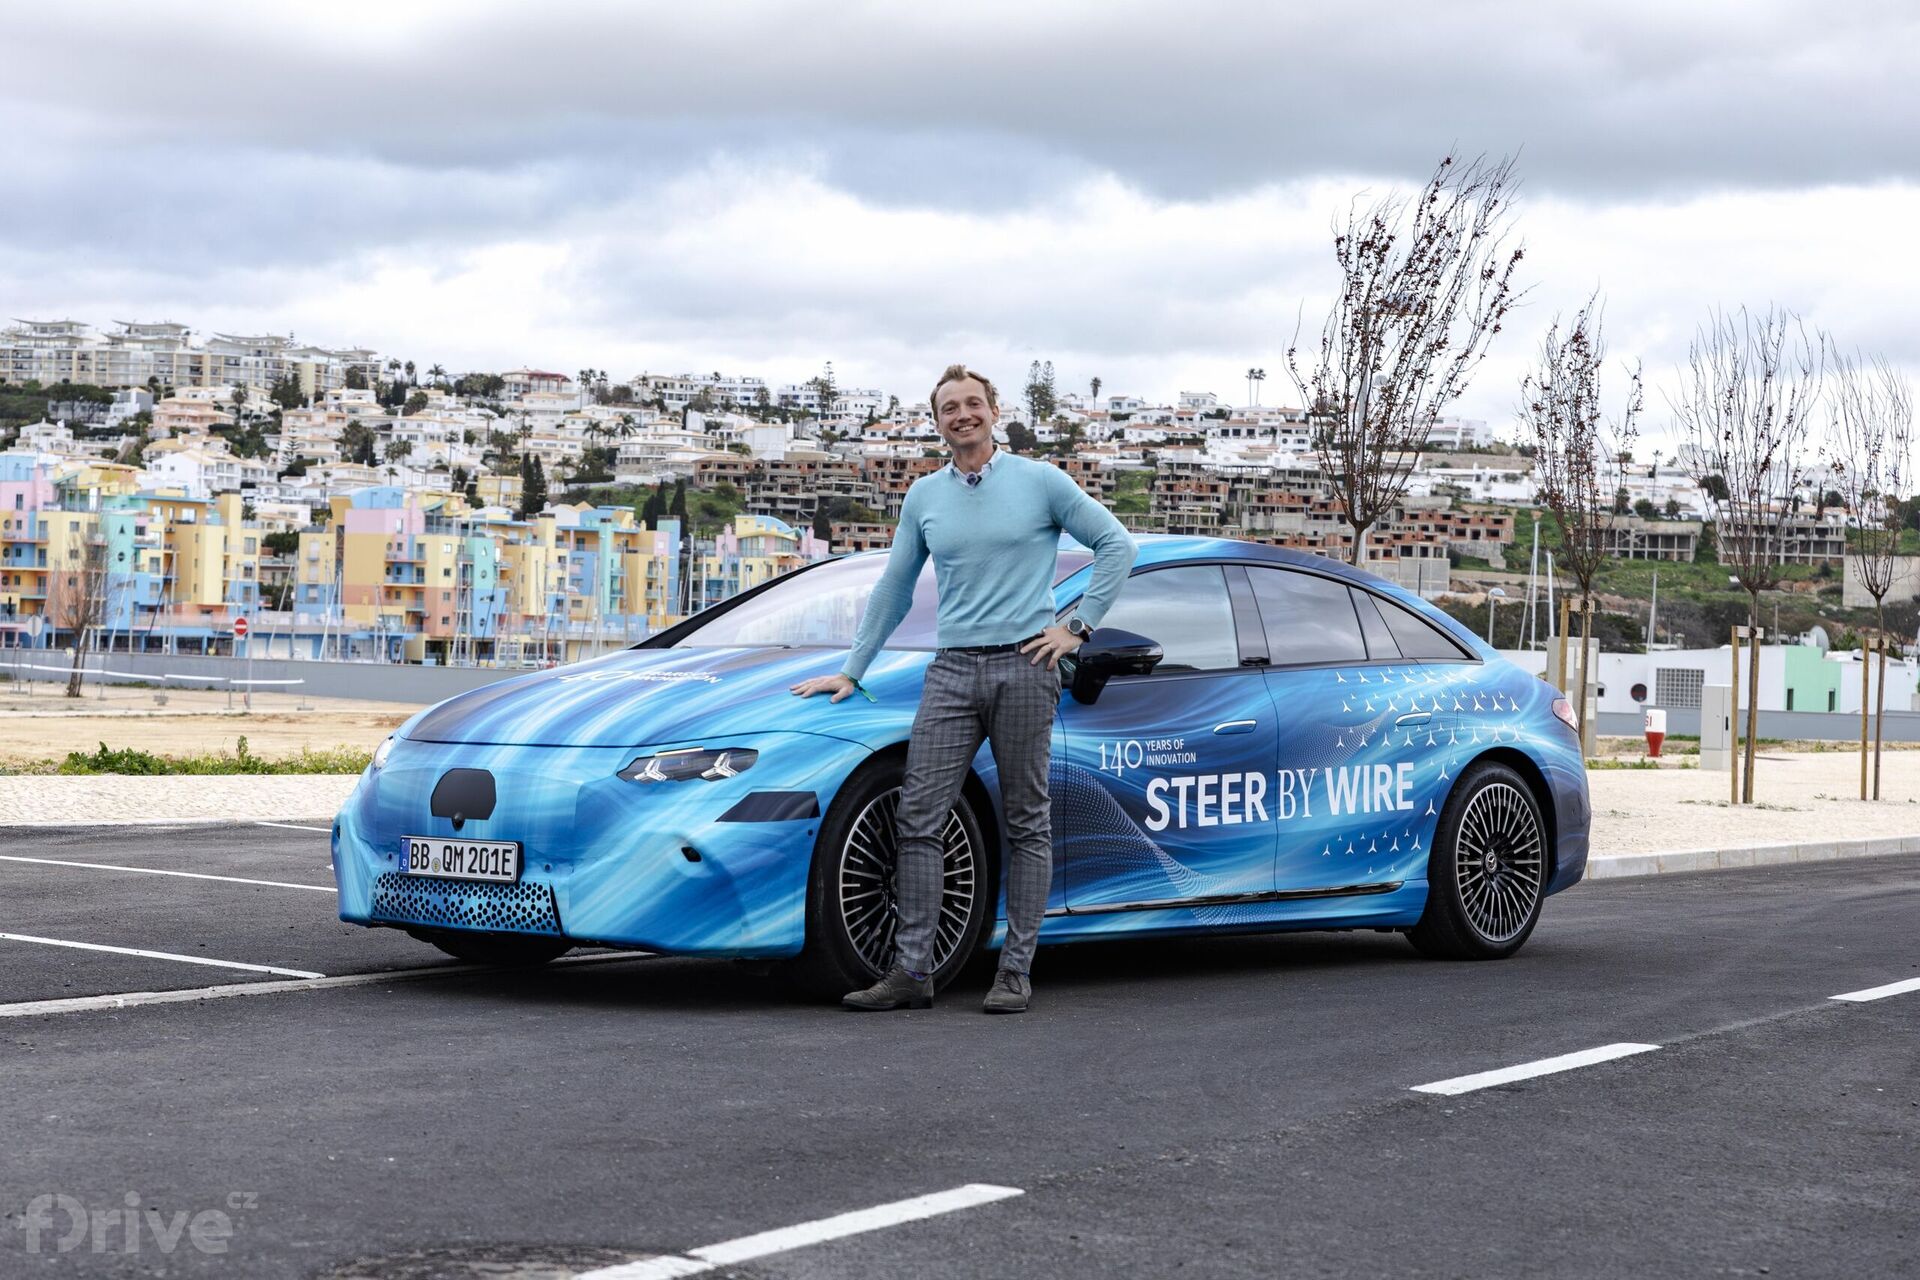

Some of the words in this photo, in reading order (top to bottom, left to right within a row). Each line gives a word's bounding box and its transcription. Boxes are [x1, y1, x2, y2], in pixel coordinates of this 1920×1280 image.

[1098, 740, 1143, 777] 140
[1145, 740, 1172, 751] YEARS
[1173, 738, 1184, 750] OF
[1146, 752, 1196, 766] INNOVATION
[1145, 772, 1269, 831] STEER
[1277, 768, 1317, 820] BY
[1325, 762, 1415, 816] WIRE
[410, 843, 430, 870] BB
[442, 845, 464, 872] QM
[468, 846, 512, 875] 201E
